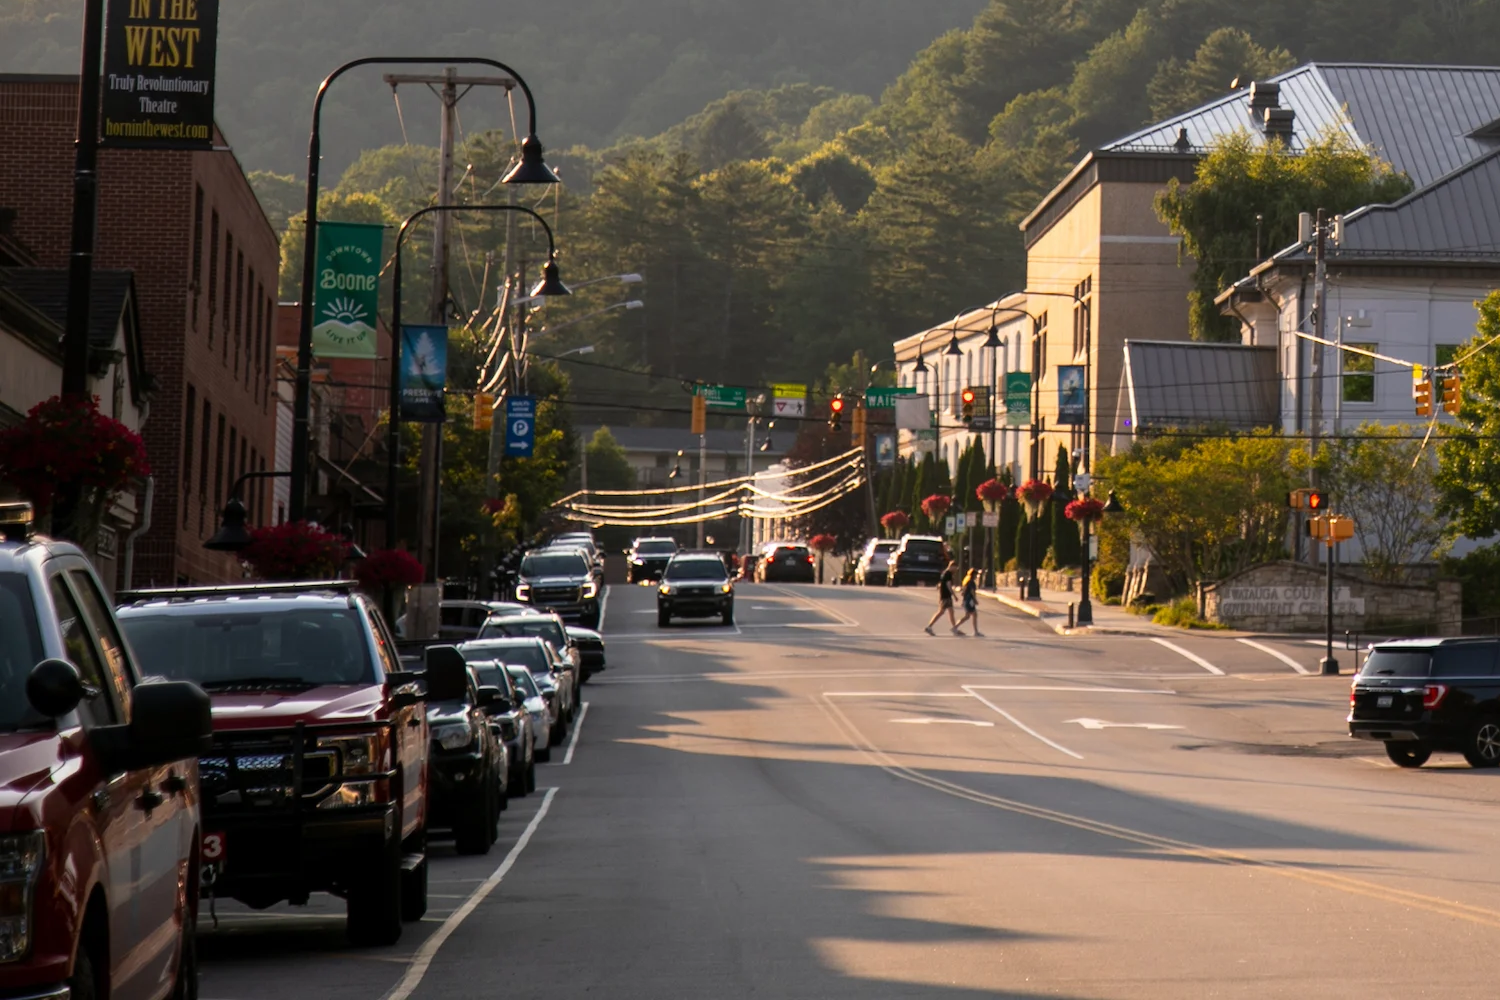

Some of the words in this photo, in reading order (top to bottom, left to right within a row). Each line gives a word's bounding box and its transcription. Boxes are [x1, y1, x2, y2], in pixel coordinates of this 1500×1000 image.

[125, 25, 200, 68] WEST
[109, 74, 134, 92] Truly
[136, 75, 209, 94] Revoluntionary
[139, 97, 178, 114] Theatre
[105, 118, 208, 139] horninthewest.com
[325, 245, 373, 263] DOWNTOWN
[320, 268, 377, 291] Boone
[325, 329, 342, 344] LIVE
[1223, 602, 1295, 615] GOVERNMENT
[203, 835, 222, 858] 3
